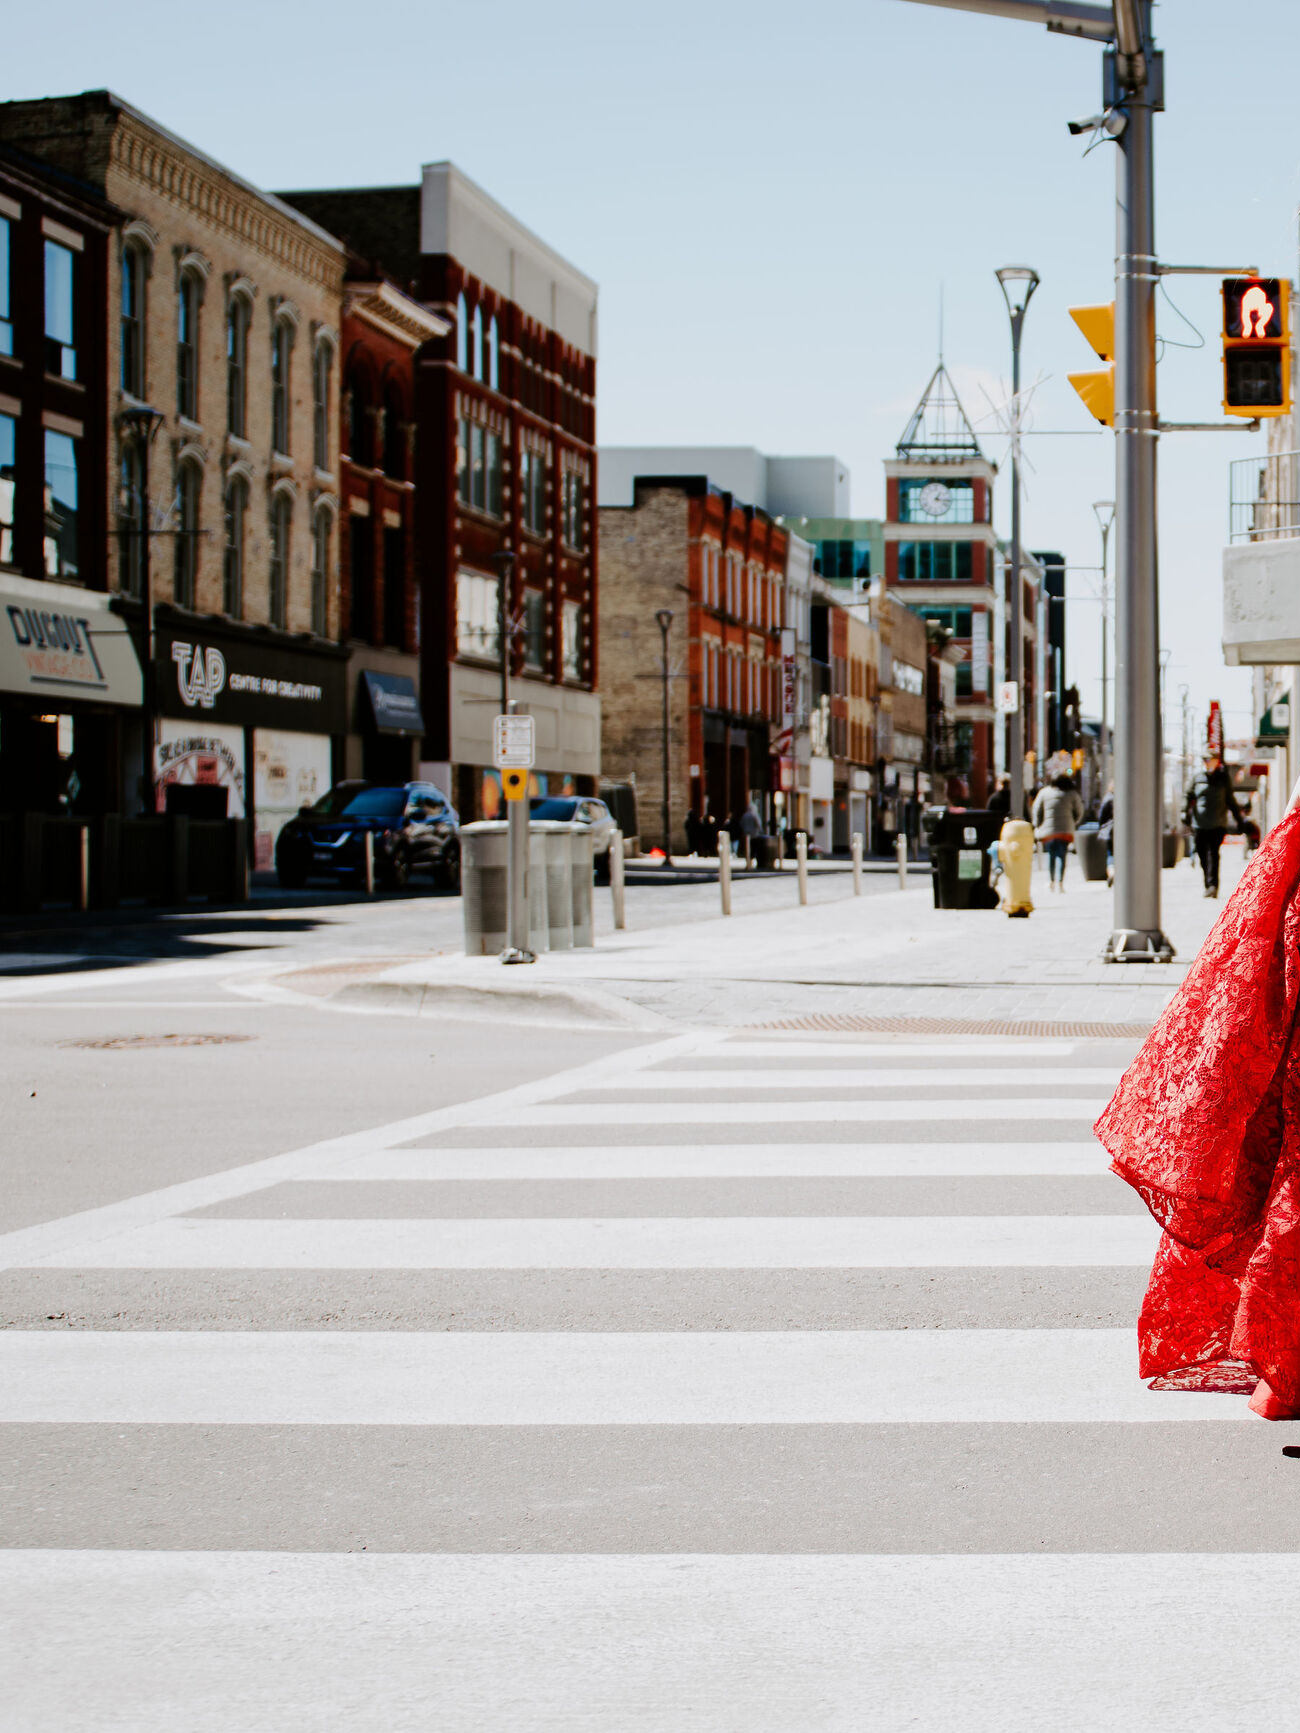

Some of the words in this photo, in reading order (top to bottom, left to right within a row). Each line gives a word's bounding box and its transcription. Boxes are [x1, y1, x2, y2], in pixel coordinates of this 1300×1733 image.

[171, 640, 227, 709] TAP
[229, 672, 261, 694] CENTRE
[261, 677, 278, 697] FOR
